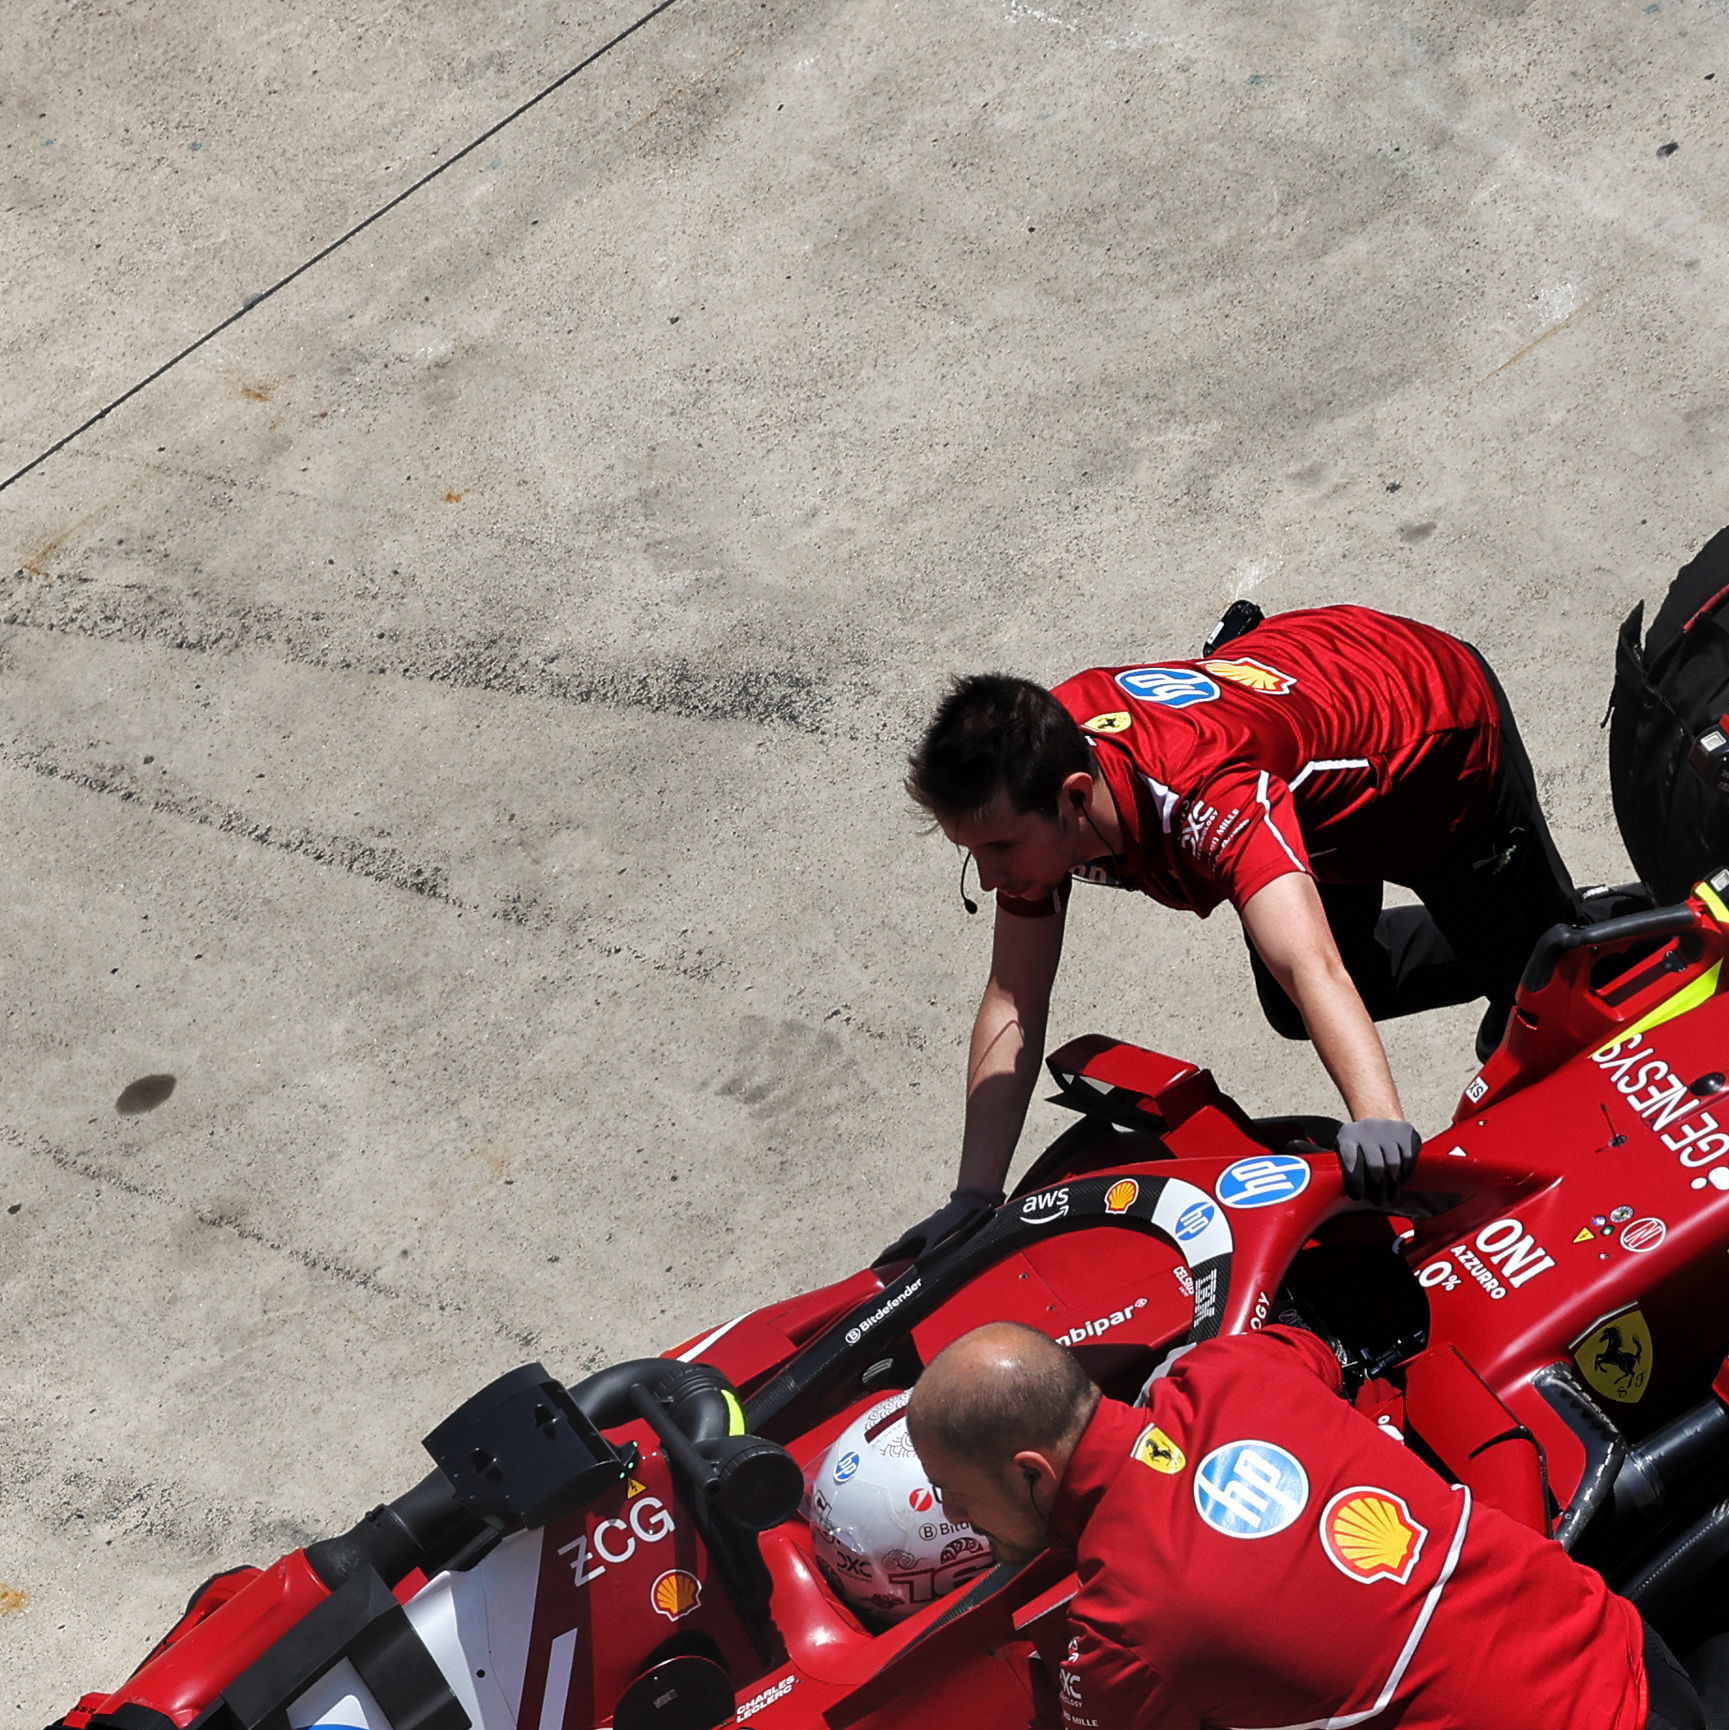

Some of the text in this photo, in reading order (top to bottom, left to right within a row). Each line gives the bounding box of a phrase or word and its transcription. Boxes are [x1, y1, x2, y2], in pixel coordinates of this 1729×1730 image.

[1117, 669, 1218, 707] hp
[1022, 1187, 1070, 1214] aws
[1218, 1155, 1310, 1207] hp
[1175, 1202, 1214, 1241] hp
[1450, 1244, 1507, 1300] AZZURRO
[857, 1276, 924, 1334] Bitdefender
[1195, 1441, 1308, 1538] hp
[736, 1674, 795, 1715] CHARLES
[736, 1684, 792, 1724] LECLERC
